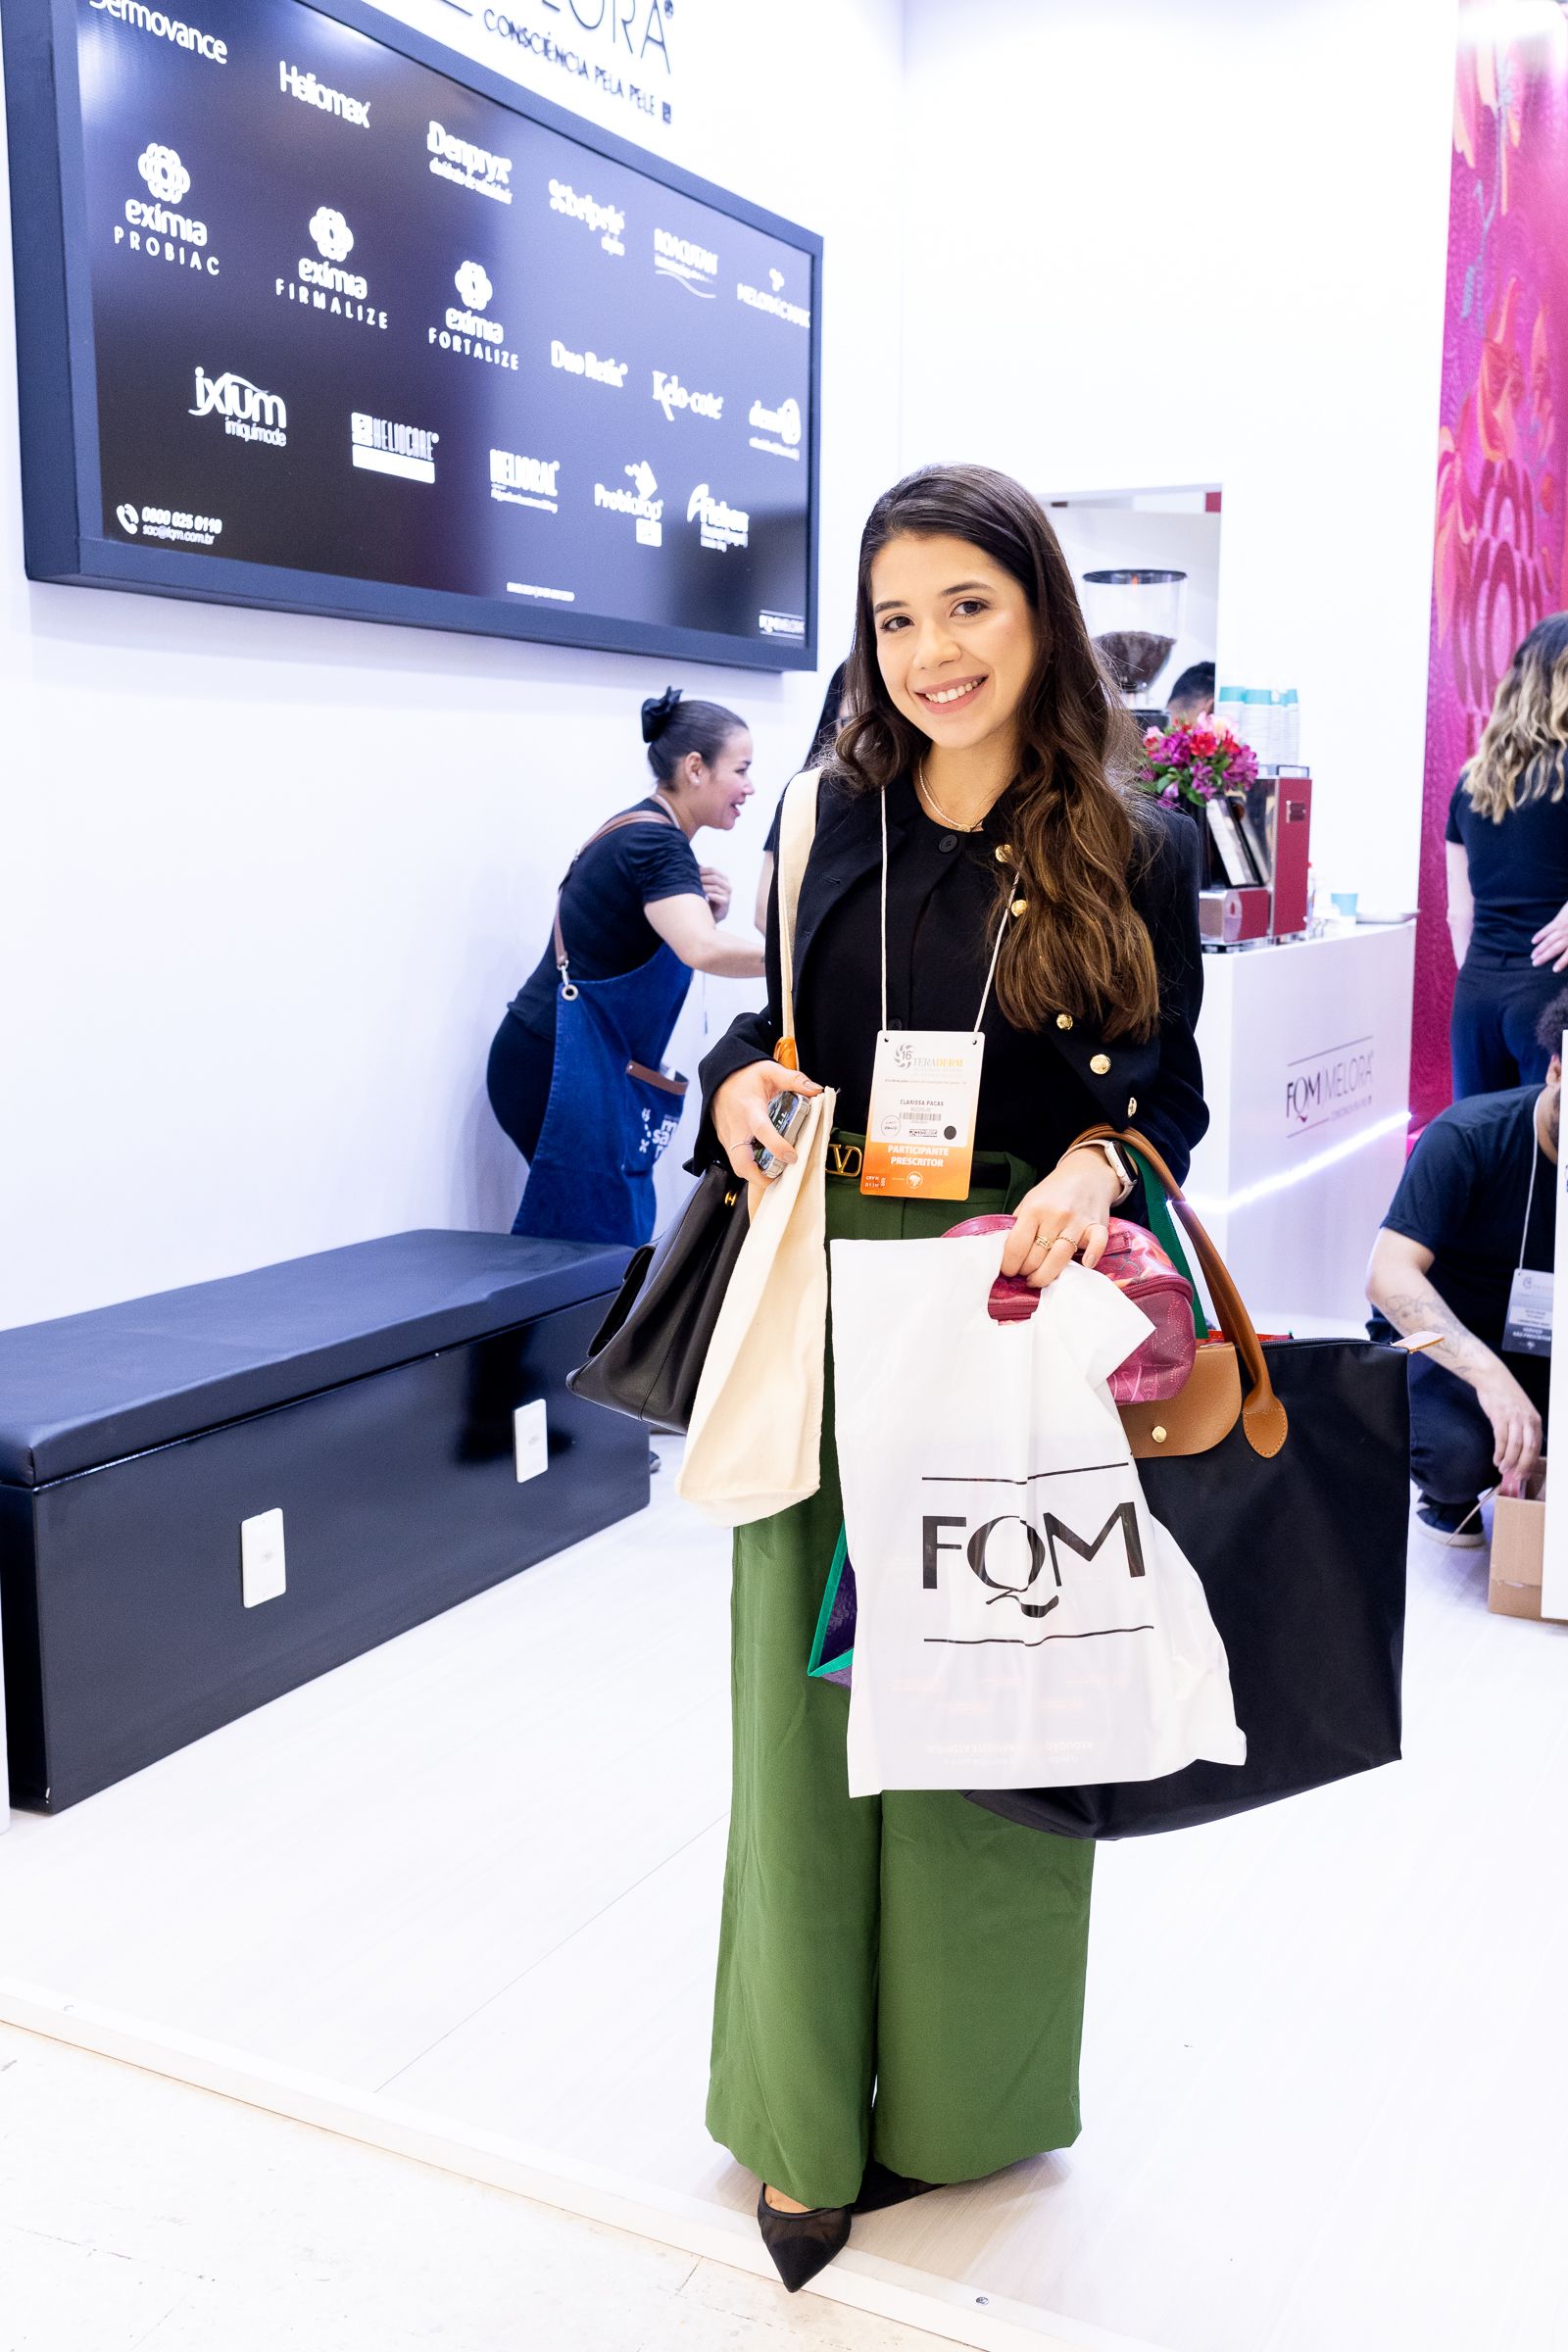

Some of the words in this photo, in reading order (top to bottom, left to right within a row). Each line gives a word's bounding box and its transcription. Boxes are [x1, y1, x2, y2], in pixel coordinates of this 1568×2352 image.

[279, 60, 371, 128] Heliomax
[594, 64, 624, 98] PELA
[628, 83, 656, 116] PELE
[114, 225, 220, 275] PROBIAC
[275, 278, 388, 329] FIRMALIZE
[428, 327, 519, 370] FORTALIZE
[188, 367, 287, 429] ixium
[224, 416, 287, 447] imiquimode
[372, 417, 439, 462] HELIOCARE
[902, 1050, 912, 1060] 16
[1286, 1071, 1320, 1123] FQM
[887, 1145, 950, 1156] PARTICIPANTE
[890, 1155, 944, 1167] PRESCRITOR
[921, 1501, 1146, 1619] FQM
